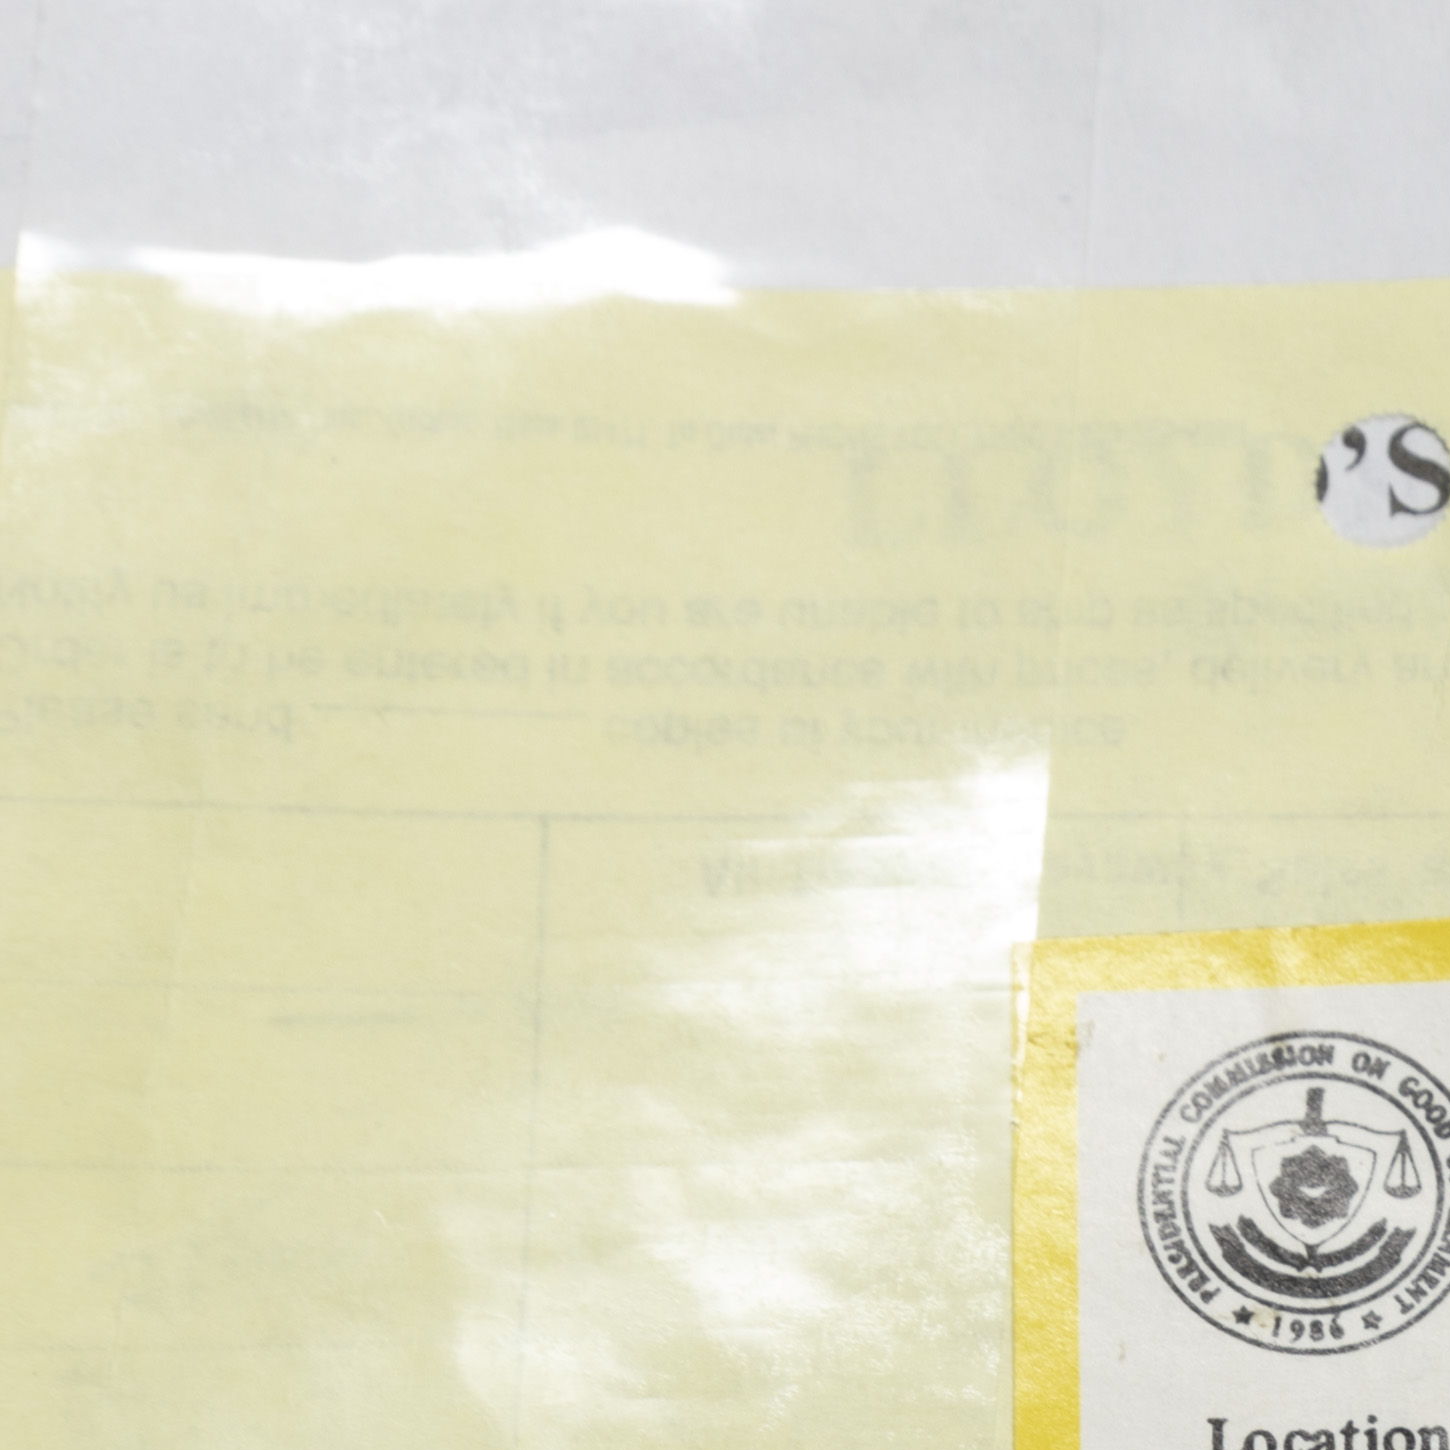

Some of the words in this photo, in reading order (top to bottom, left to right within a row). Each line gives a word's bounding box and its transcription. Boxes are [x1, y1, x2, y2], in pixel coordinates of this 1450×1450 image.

[1180, 1045, 1336, 1124] COMMISSION
[1351, 1050, 1392, 1081] ON
[1271, 1314, 1346, 1343] 1986
